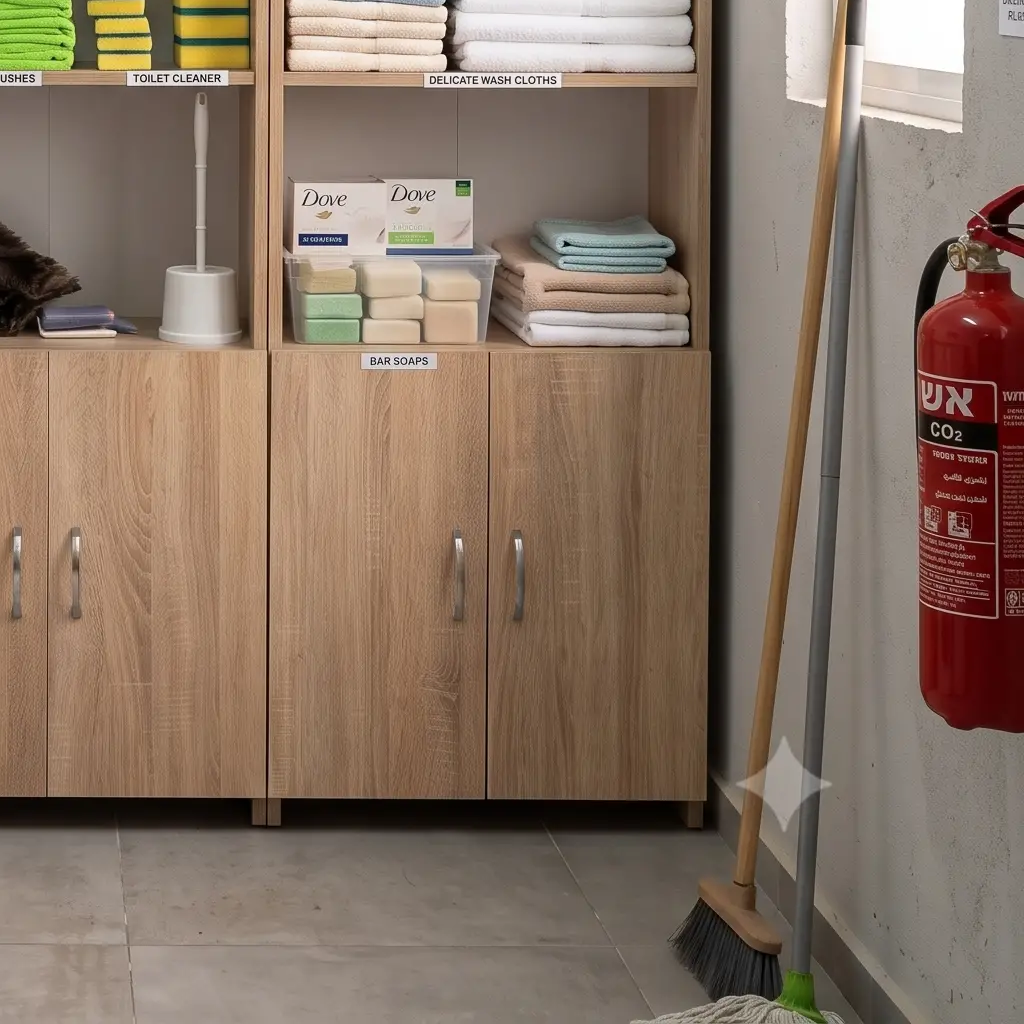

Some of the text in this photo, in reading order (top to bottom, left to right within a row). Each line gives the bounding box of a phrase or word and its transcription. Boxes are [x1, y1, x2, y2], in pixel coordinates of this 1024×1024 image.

[133, 74, 222, 83] TOILET CLEANER
[429, 75, 557, 85] DELICATE WASH CLOTHS
[301, 188, 348, 207] Dove
[390, 183, 436, 202] Dove
[370, 356, 429, 366] BAR SOAPS
[921, 380, 974, 417] אש
